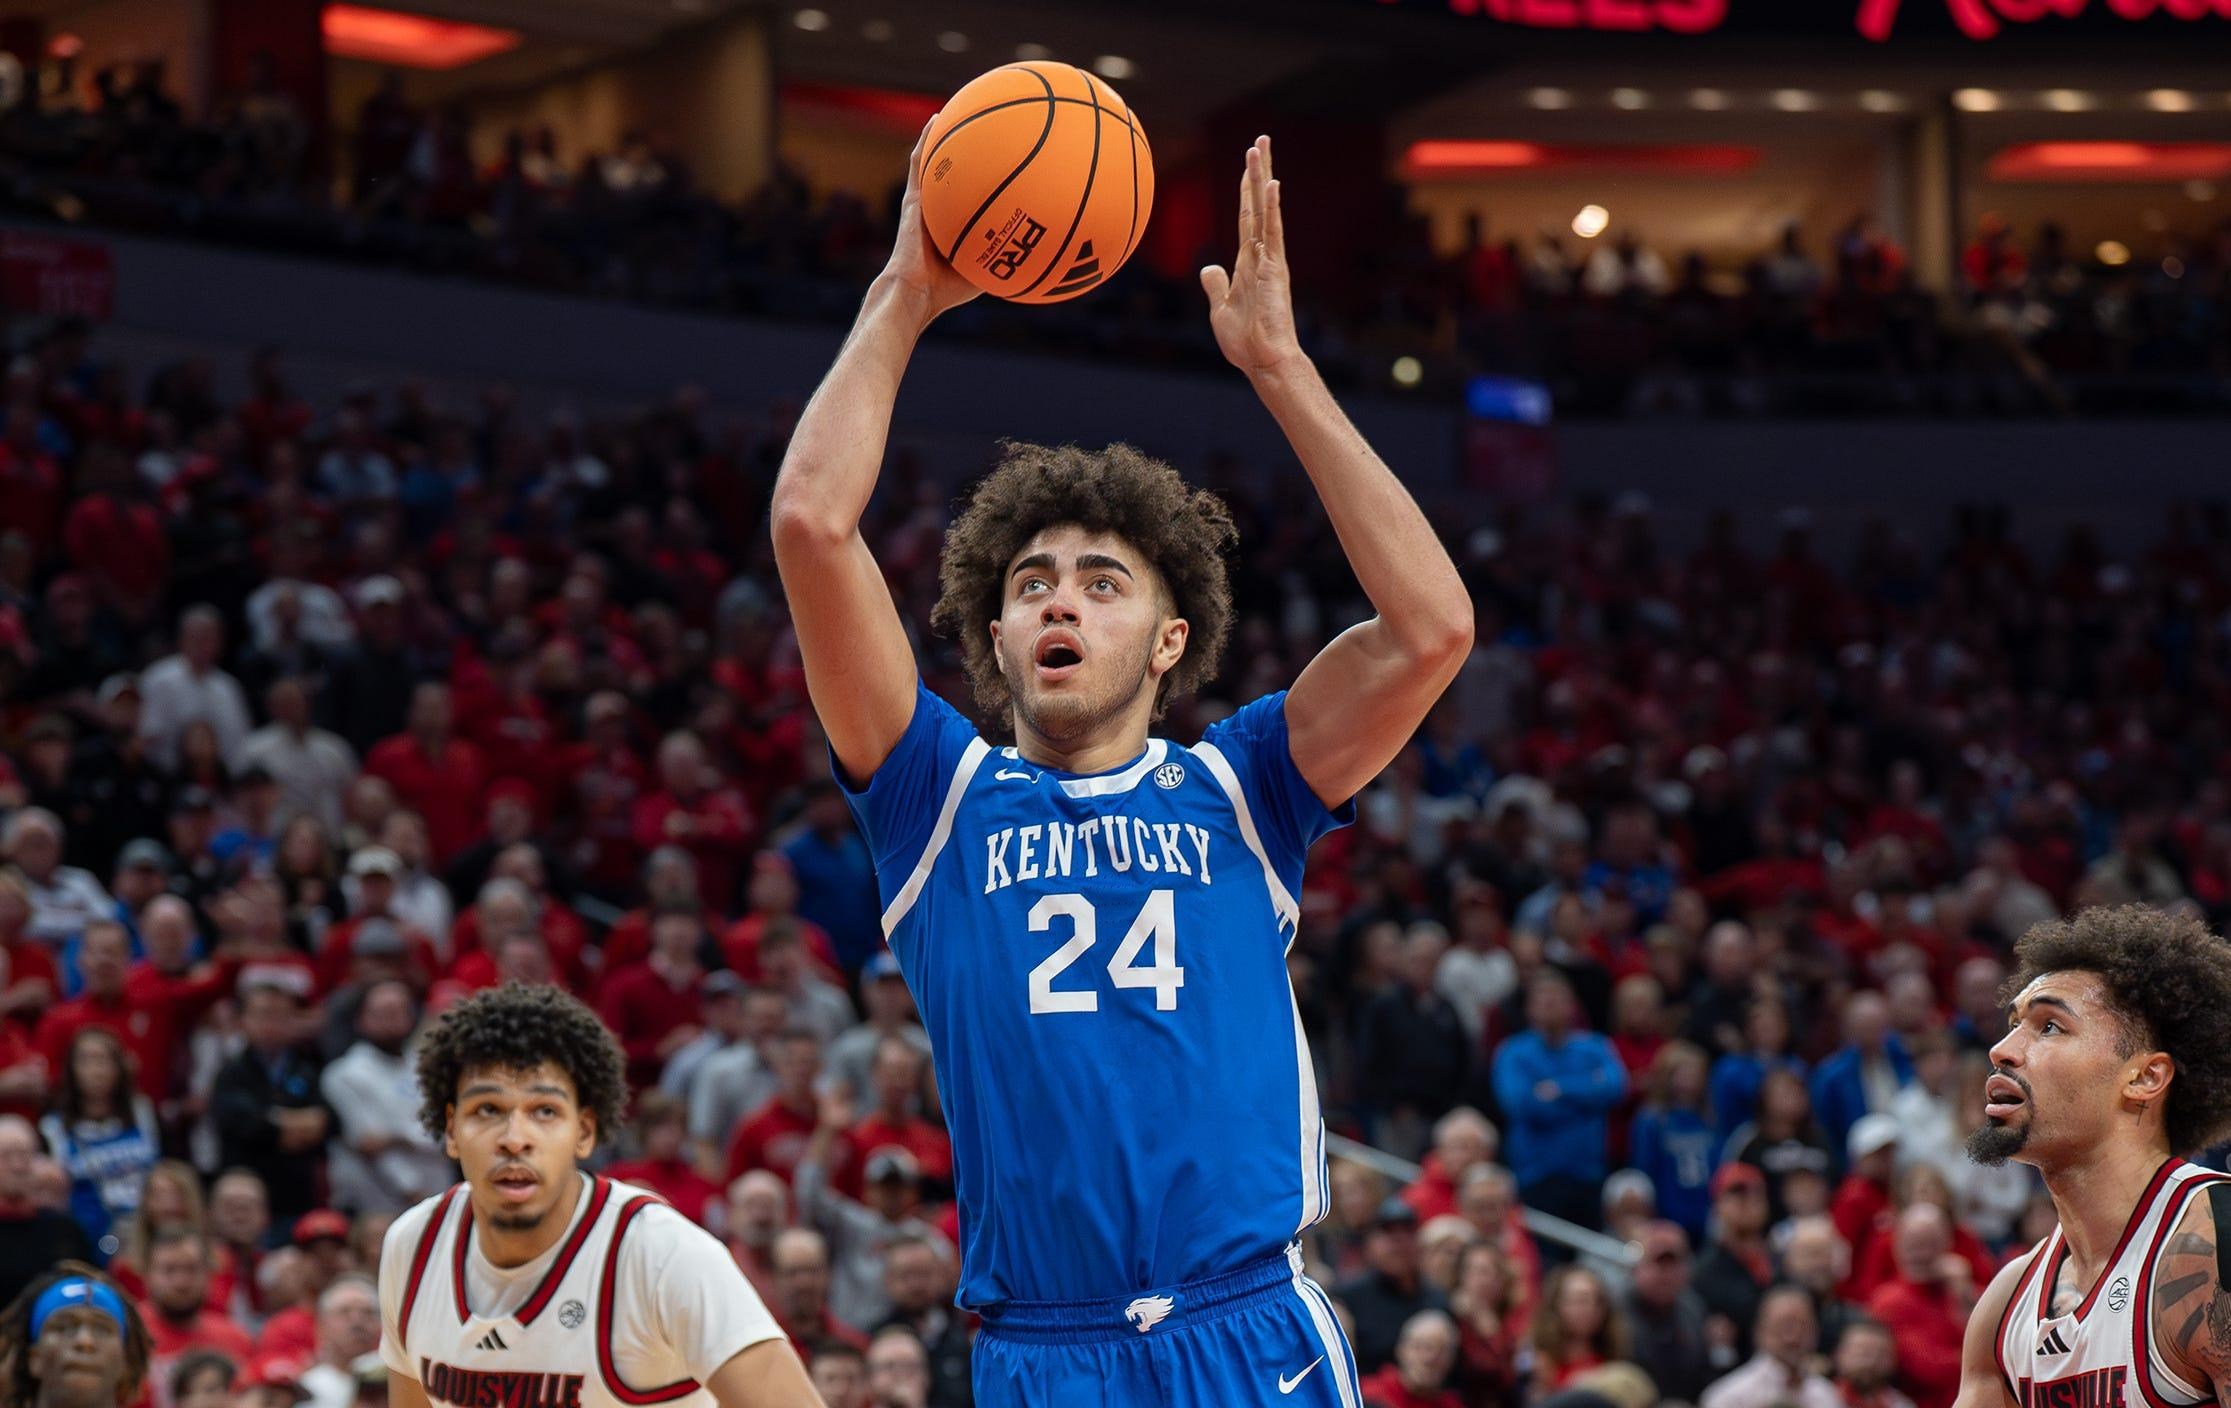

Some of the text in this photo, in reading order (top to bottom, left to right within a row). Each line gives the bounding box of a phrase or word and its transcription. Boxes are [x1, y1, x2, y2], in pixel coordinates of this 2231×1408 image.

[988, 217, 1048, 281] PRO
[1156, 764, 1183, 787] SEC
[984, 815, 1212, 895] KENTUCKY
[1027, 888, 1185, 1015] 24
[420, 1355, 584, 1408] LOUISVILLE
